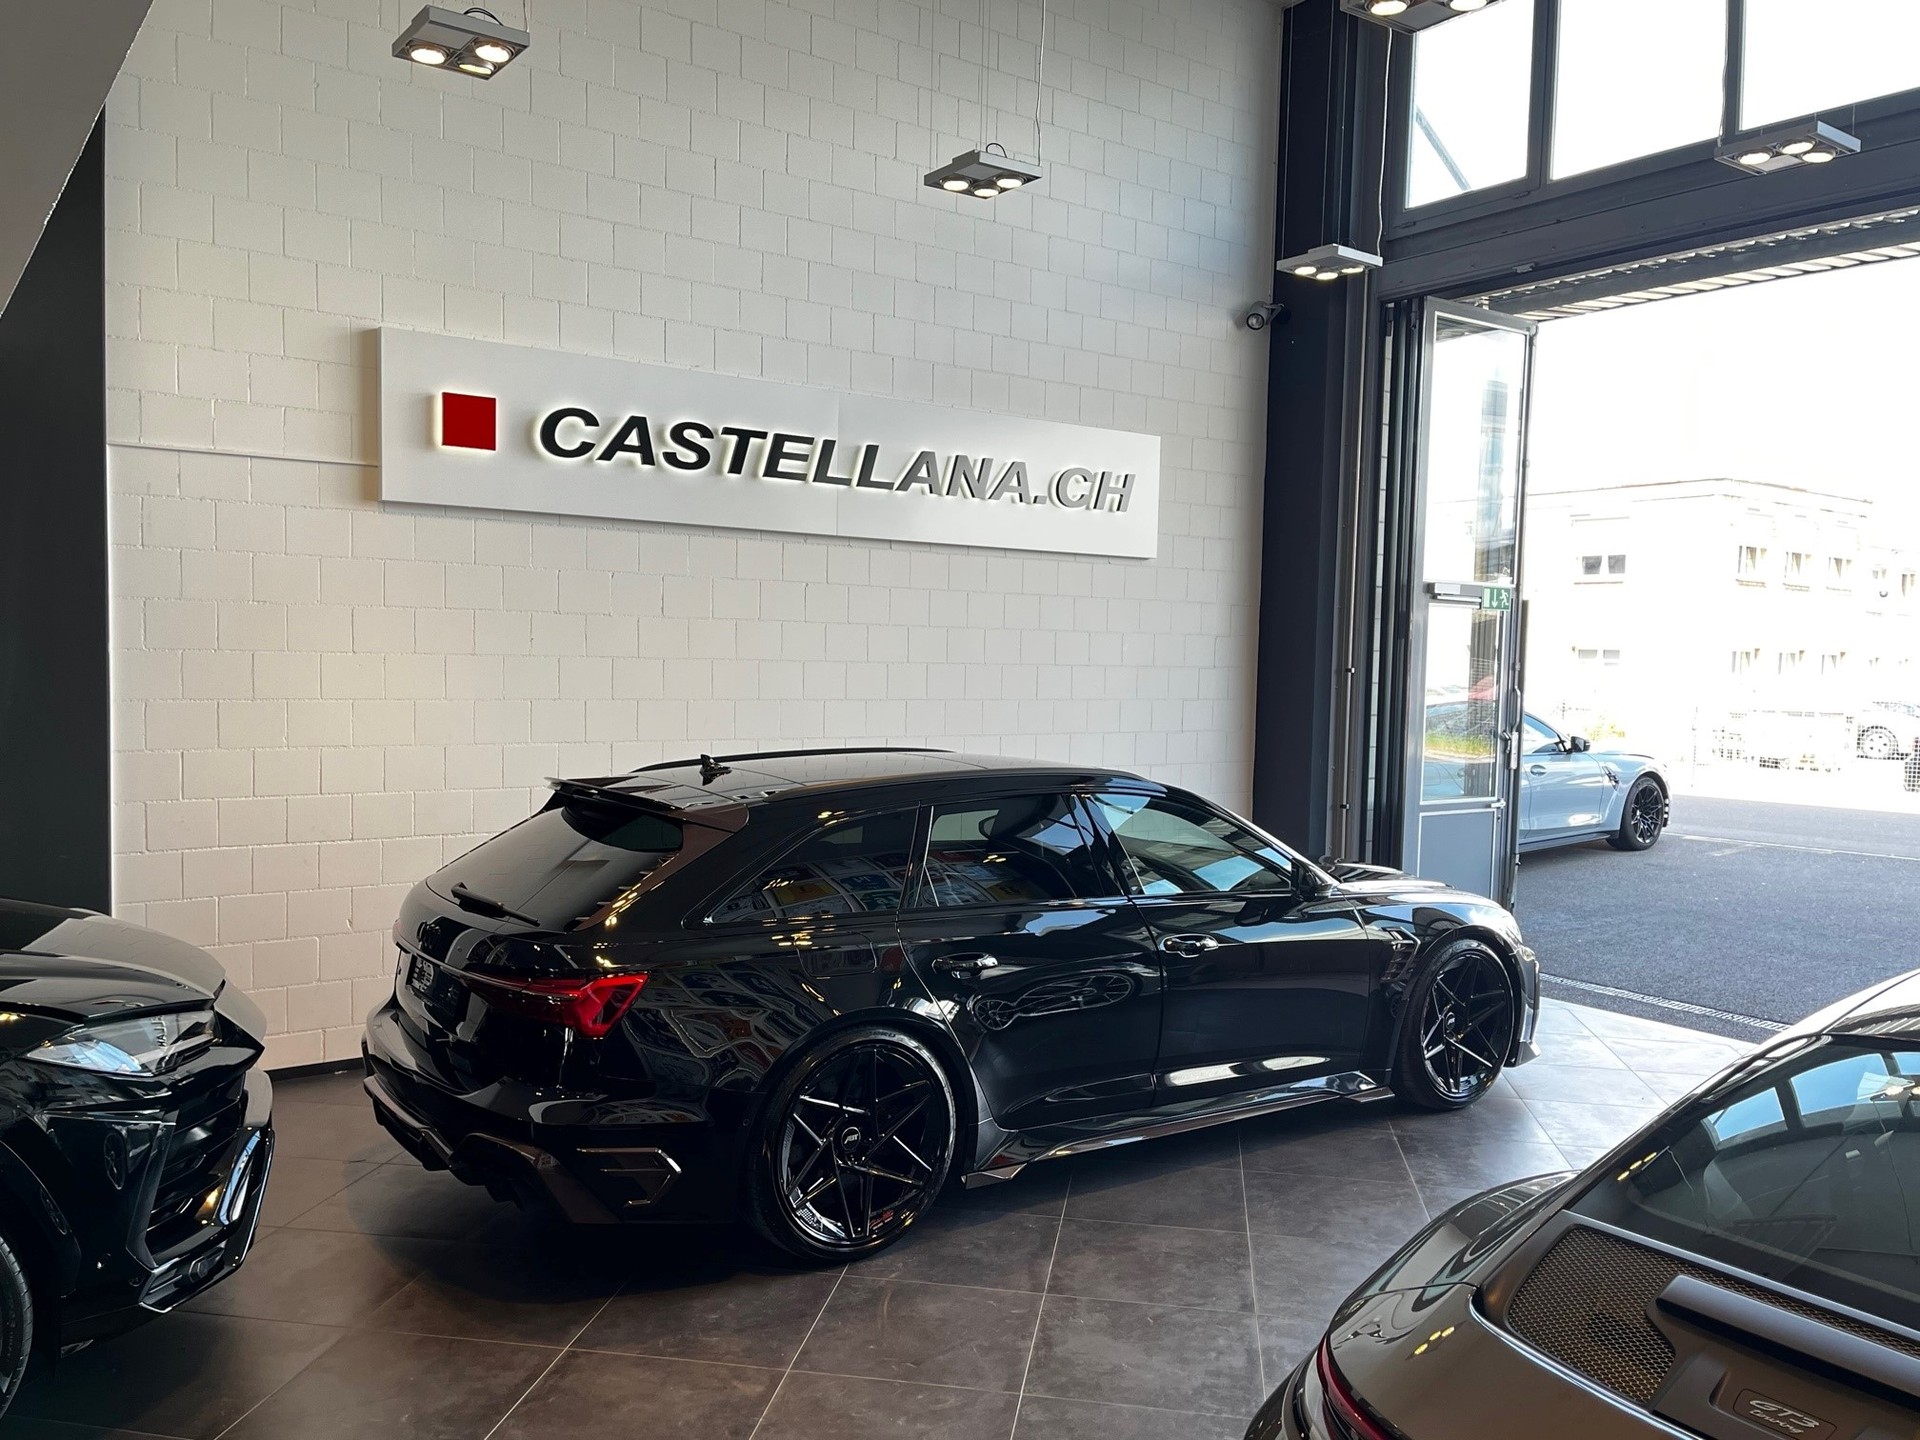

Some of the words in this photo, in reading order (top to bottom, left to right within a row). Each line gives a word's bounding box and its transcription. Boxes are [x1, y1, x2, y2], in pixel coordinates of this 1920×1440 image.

[540, 407, 1136, 513] CASTELLANA.CH
[844, 1133, 860, 1145] ABT
[1749, 1400, 1819, 1428] GT3
